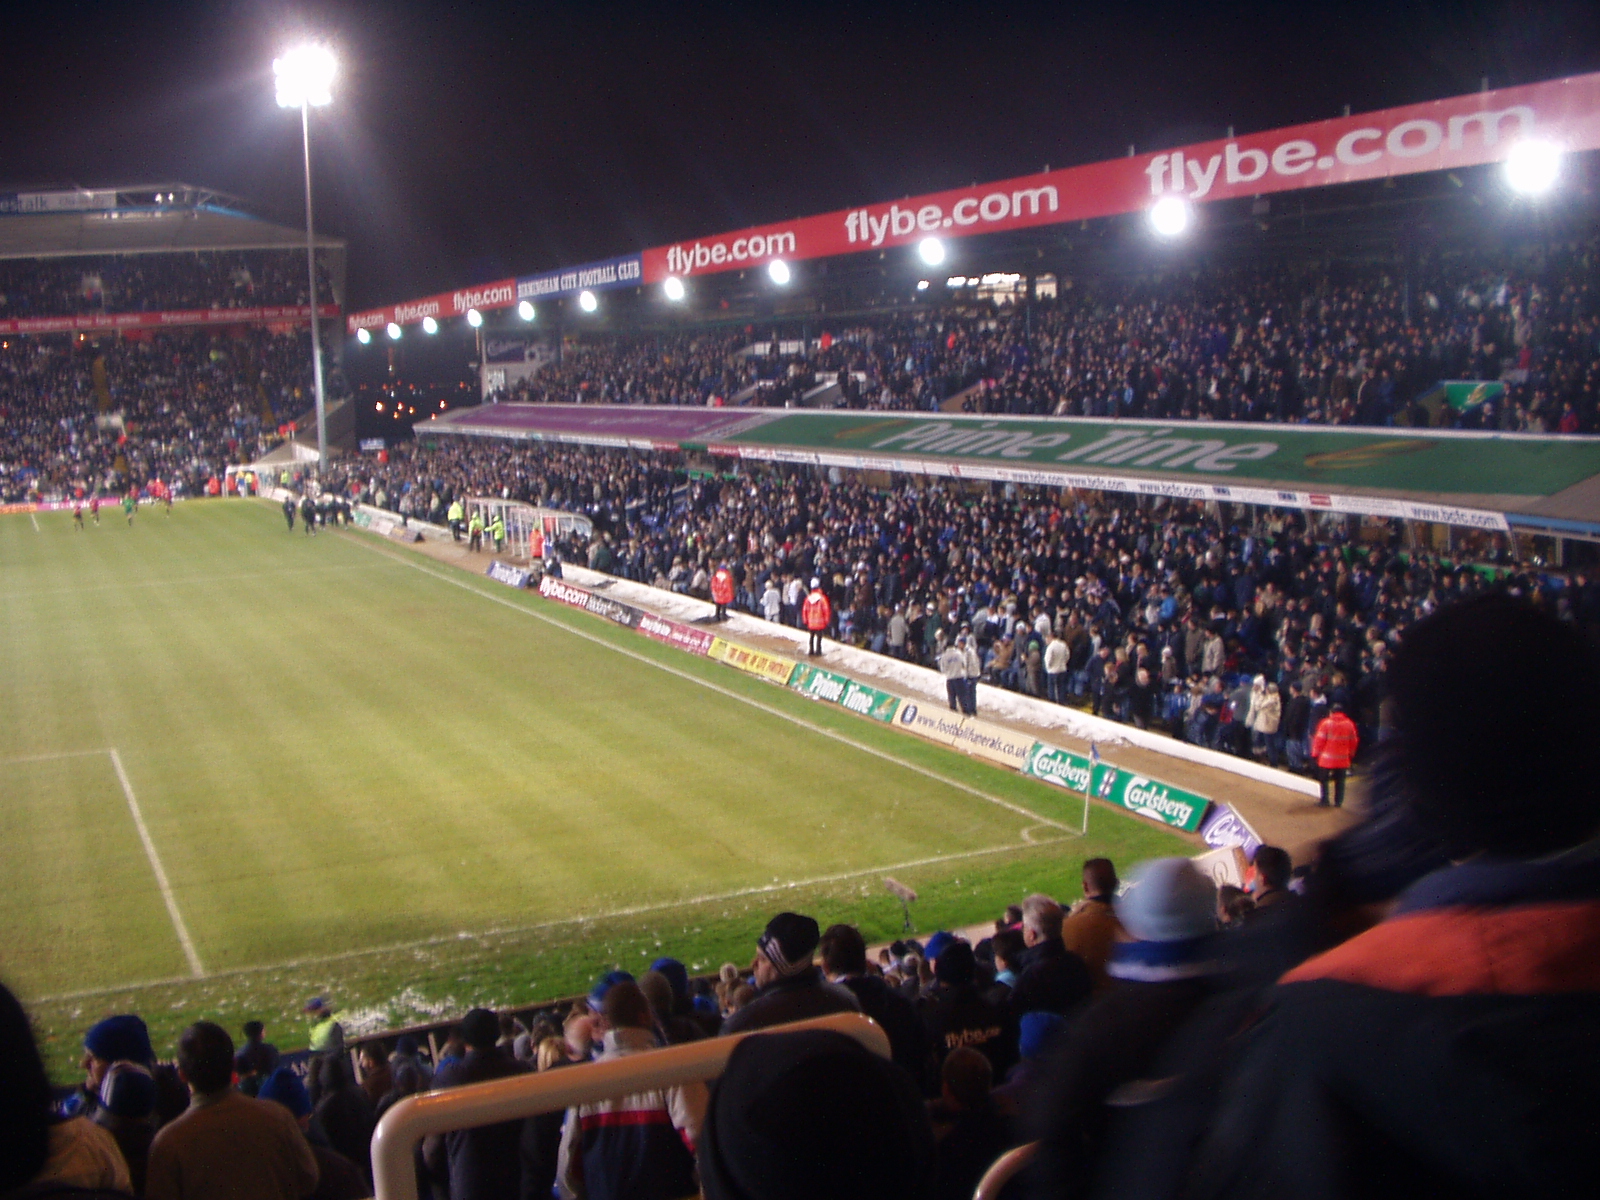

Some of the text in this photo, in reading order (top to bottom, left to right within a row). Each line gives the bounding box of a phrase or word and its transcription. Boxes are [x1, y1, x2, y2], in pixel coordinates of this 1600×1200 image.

[1144, 104, 1537, 199] flybe.com
[844, 185, 1058, 246] flybe.com
[667, 231, 796, 275] flybe.com
[453, 284, 512, 313] flybe.com
[517, 260, 640, 298] BIRMINGHAM CITY FOOTBALL CLUB
[349, 312, 385, 331] flybe.com
[394, 300, 439, 324] flybe.com
[871, 421, 1279, 471] Prime Time
[1411, 506, 1499, 527] www.bcfc.com
[540, 576, 589, 606] flybe.com
[809, 672, 873, 714] Prime Time
[917, 714, 1028, 759] www.footballfunerals.co.uk
[1032, 744, 1090, 792] Carlsberg
[1124, 775, 1194, 827] Carlsberg
